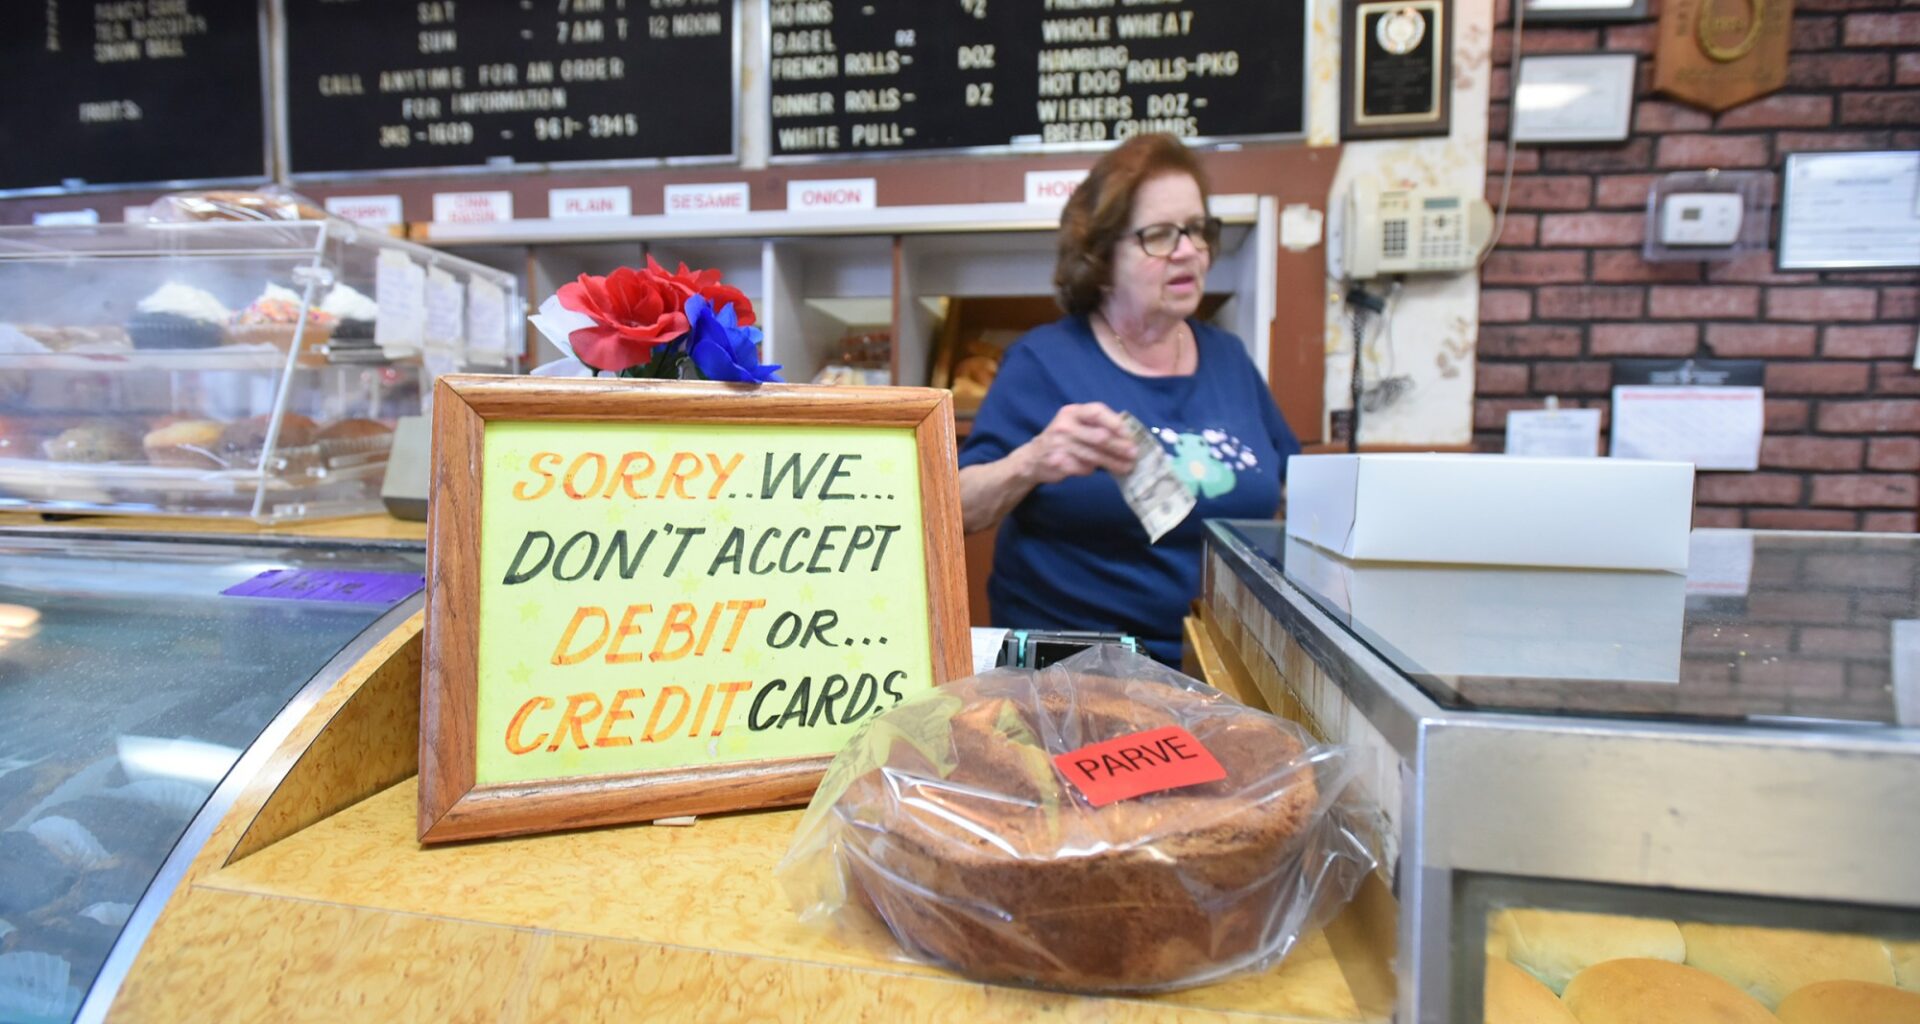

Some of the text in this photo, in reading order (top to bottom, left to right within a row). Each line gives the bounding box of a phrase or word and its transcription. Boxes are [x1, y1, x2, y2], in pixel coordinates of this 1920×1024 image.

[418, 1, 455, 25] SAT
[1041, 10, 1195, 43] WHOLE WHEAT
[418, 30, 457, 53] SUN
[572, 19, 605, 43] AM
[672, 12, 722, 38] NOON
[772, 29, 837, 55] BAGEL
[772, 54, 839, 80] FRENCH
[957, 44, 996, 70] DOZ
[1037, 44, 1129, 72] HAMBURG
[318, 56, 625, 97] CALL ANYTIME FOR AN ORDER
[1038, 69, 1122, 97] HOT DOG
[402, 86, 568, 120] FOR INFORMATION
[771, 91, 835, 118] DINNER
[965, 82, 994, 107] DZ
[1037, 95, 1133, 123] WIENERS
[778, 125, 841, 151] WHITE
[565, 198, 615, 214] PLAIN
[670, 191, 743, 209] SESAME
[801, 188, 862, 207] ONION
[502, 522, 901, 586] DON'T ACCEPT
[550, 598, 767, 666] DEBIT
[504, 670, 909, 756] CREDIT CARDS
[1074, 735, 1199, 782] PARVE
